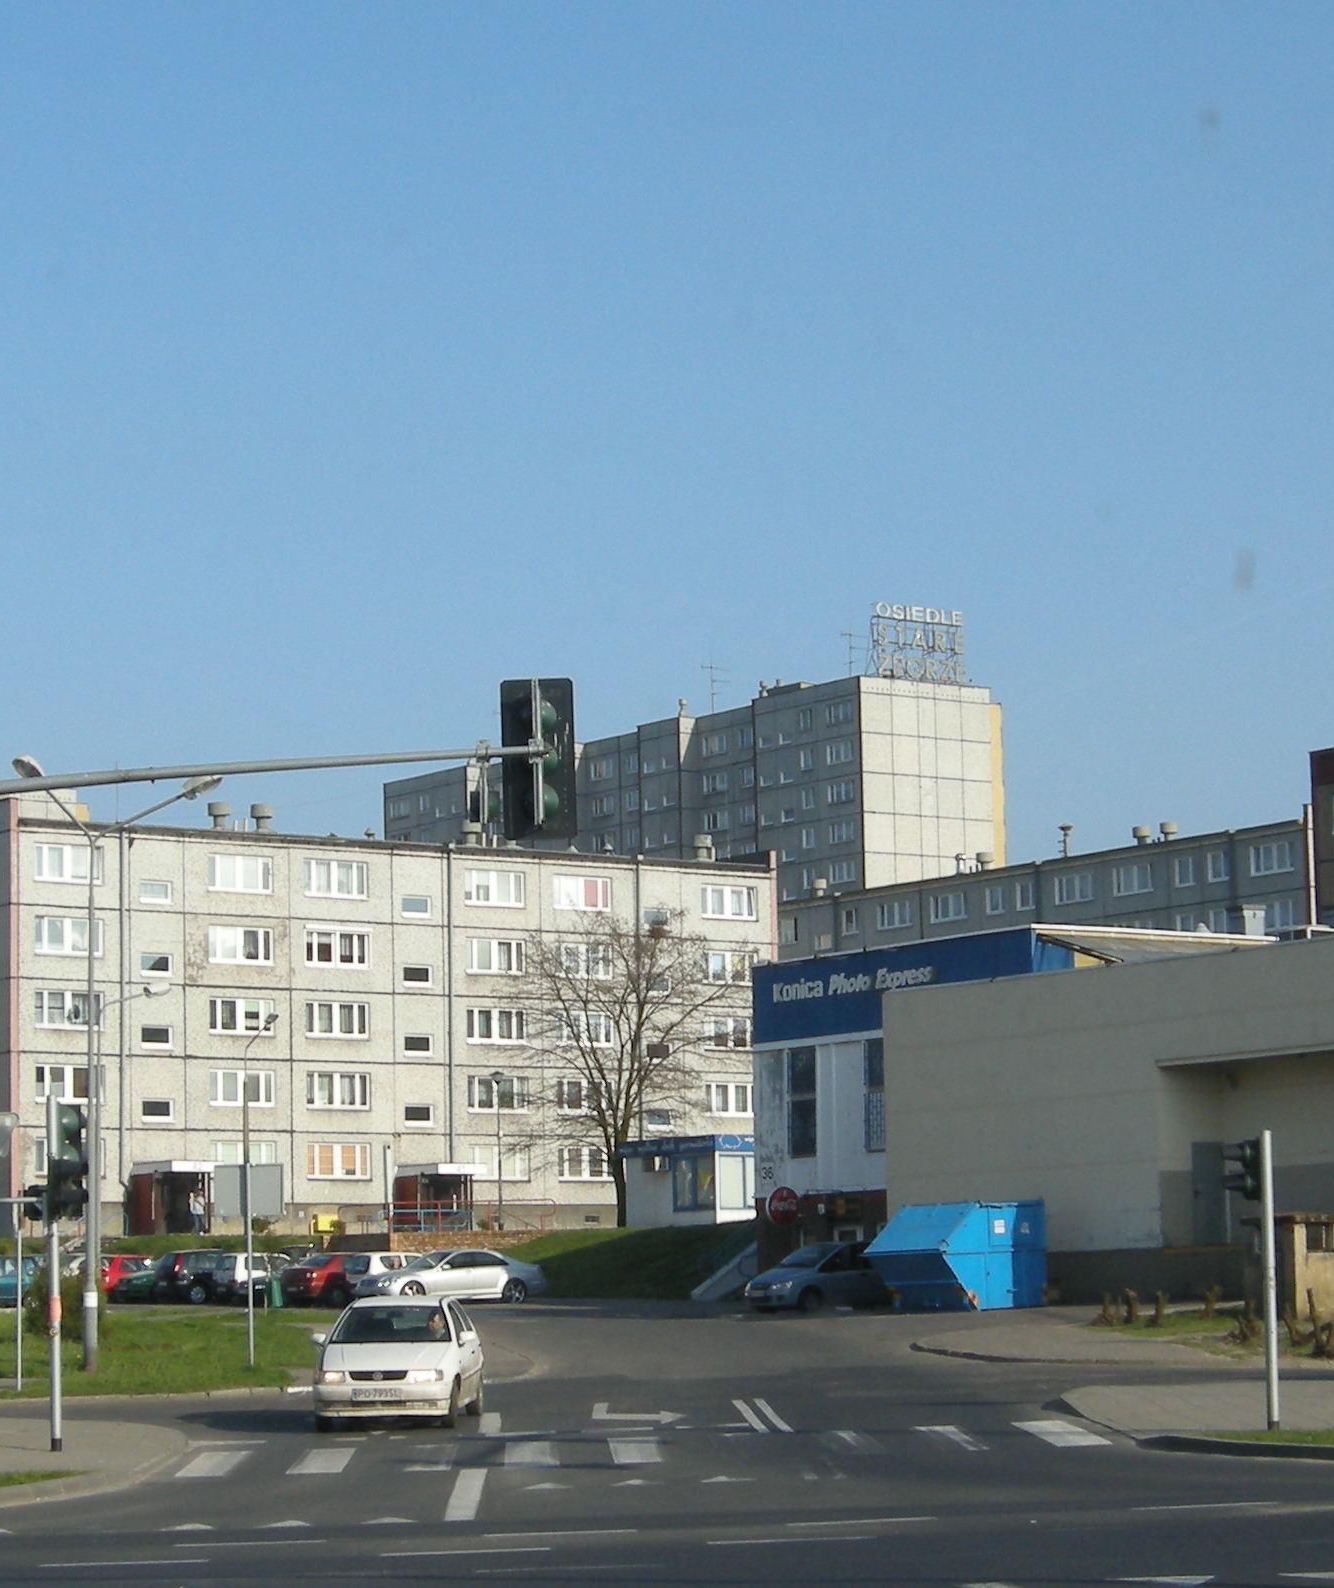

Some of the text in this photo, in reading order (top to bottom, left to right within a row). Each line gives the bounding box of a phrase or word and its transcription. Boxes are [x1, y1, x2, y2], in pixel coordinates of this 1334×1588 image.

[875, 602, 964, 626] OSIEDLE
[876, 624, 966, 655] STARE
[772, 966, 933, 1003] Konica Photo Express
[761, 1166, 774, 1180] 36
